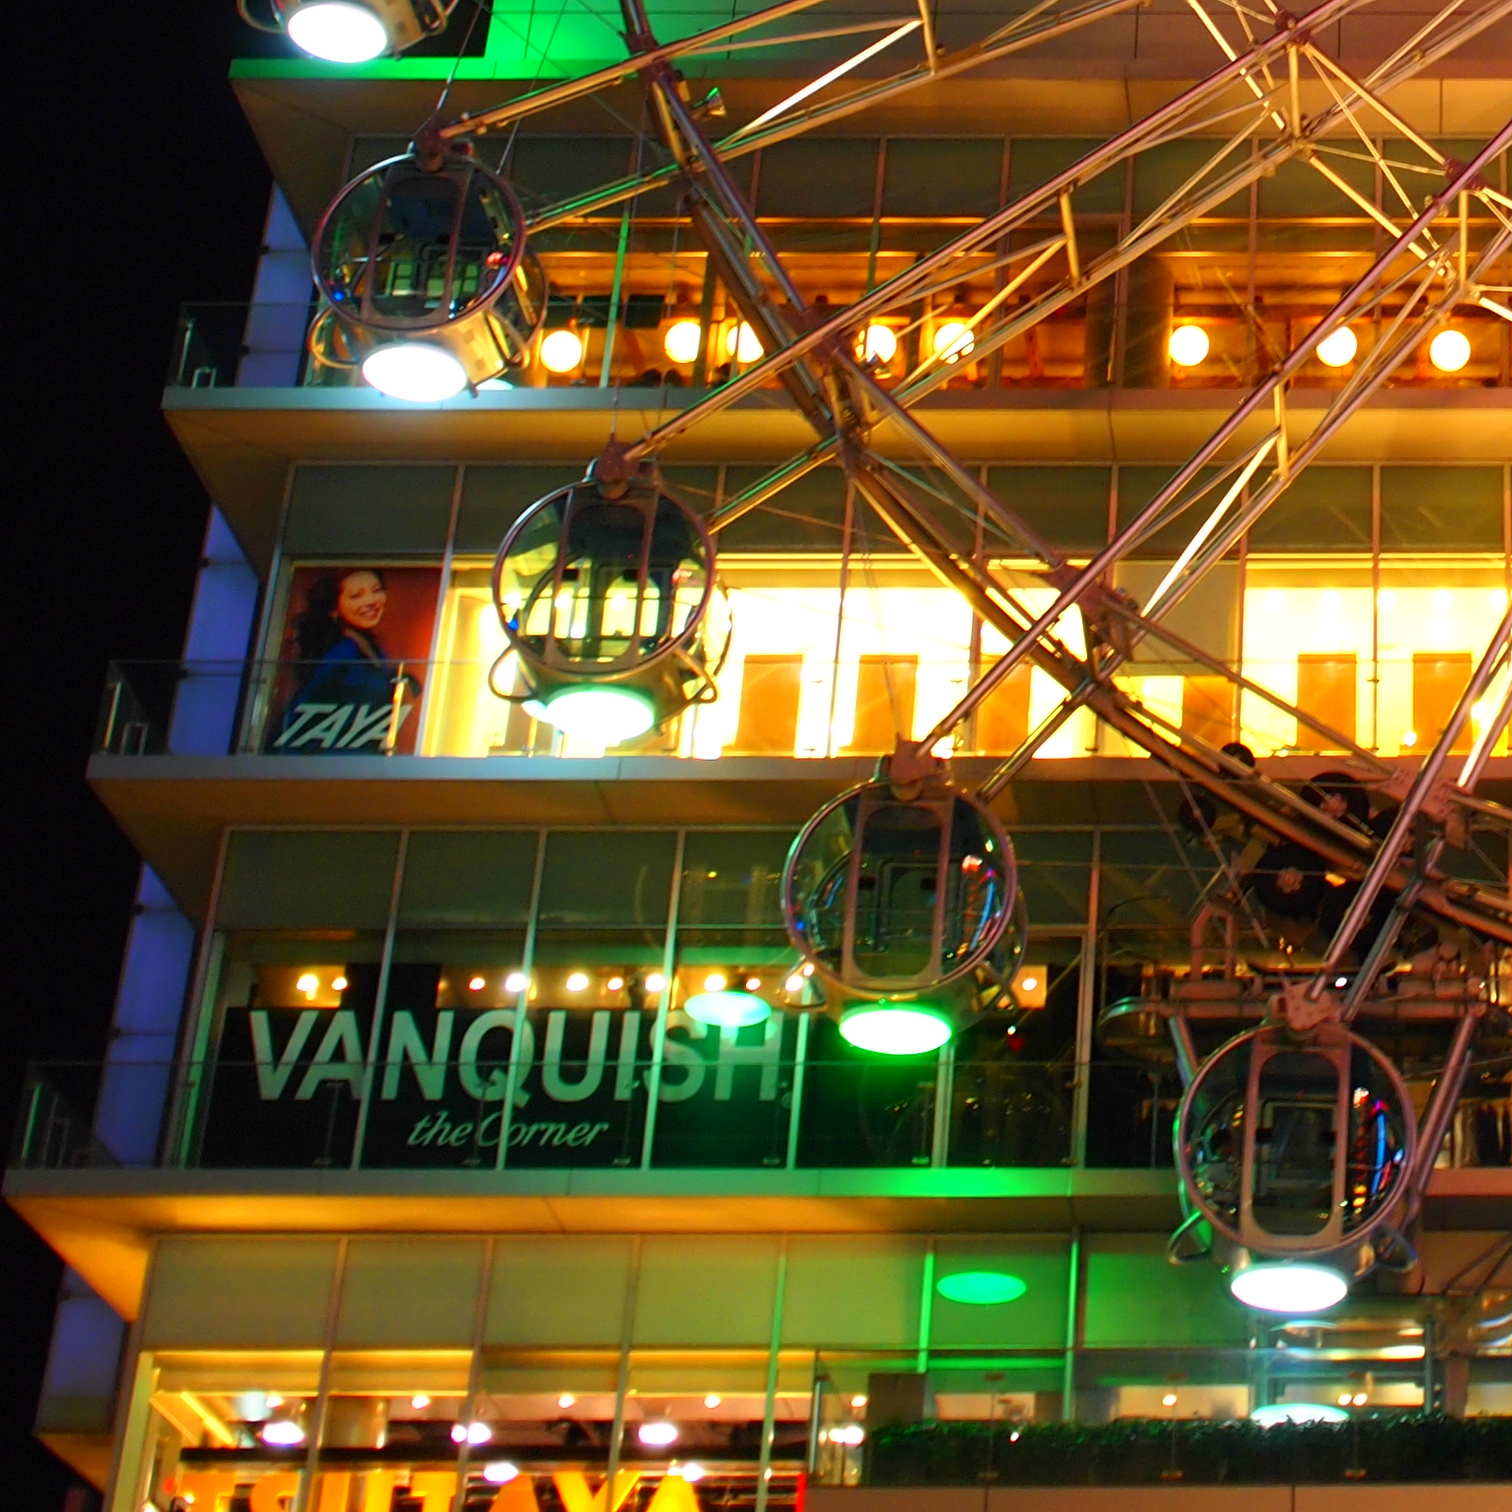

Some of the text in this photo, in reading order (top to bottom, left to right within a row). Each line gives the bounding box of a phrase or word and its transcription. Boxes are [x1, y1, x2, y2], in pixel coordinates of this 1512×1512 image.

[272, 703, 414, 750] TAYA
[249, 1009, 783, 1108] VANQUISH
[406, 1110, 609, 1149] the Corner
